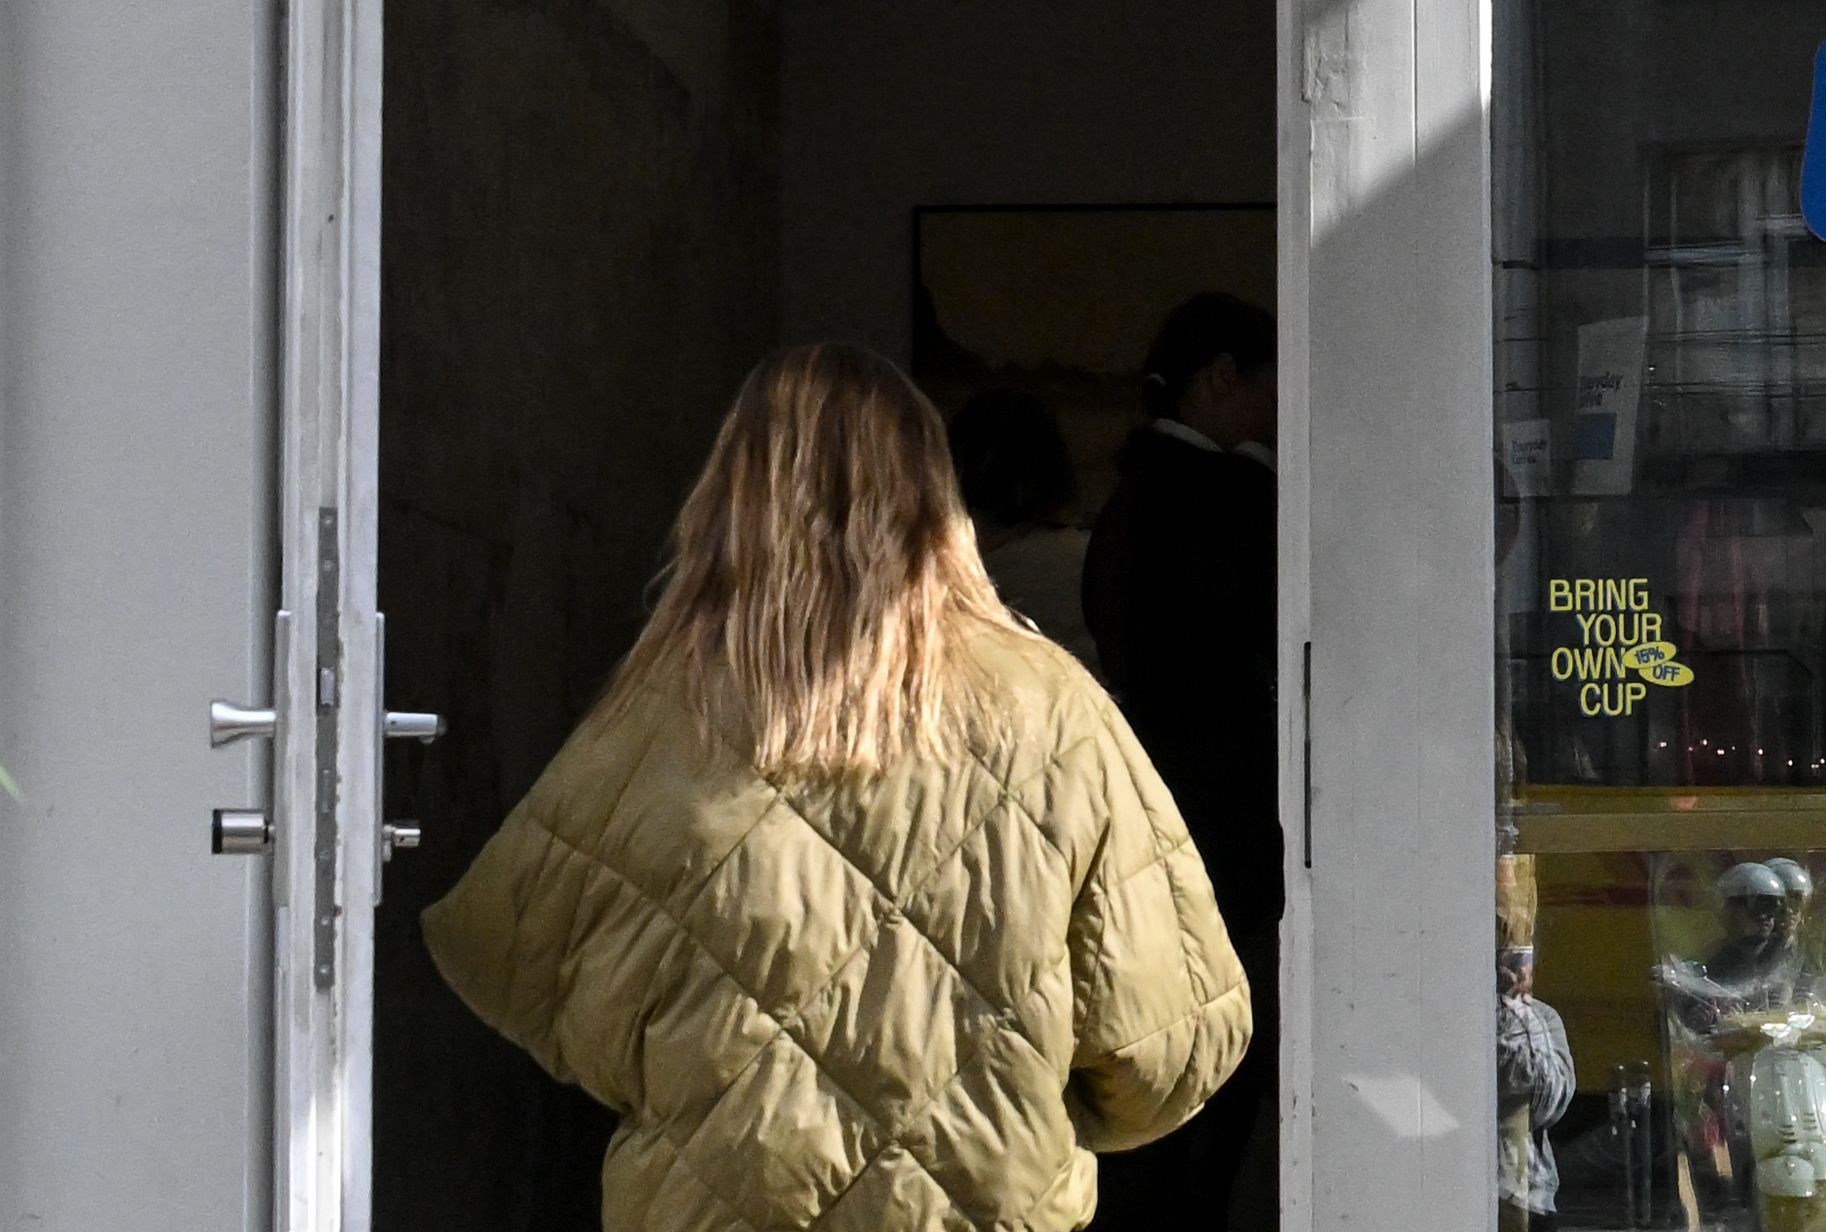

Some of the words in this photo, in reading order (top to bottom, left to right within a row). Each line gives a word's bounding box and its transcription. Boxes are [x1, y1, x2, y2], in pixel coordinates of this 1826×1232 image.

[1550, 578, 1649, 611] BRING
[1576, 613, 1662, 646] YOUR
[1552, 647, 1627, 681] OWN
[1652, 666, 1681, 682] OFF
[1580, 683, 1647, 716] CUP
